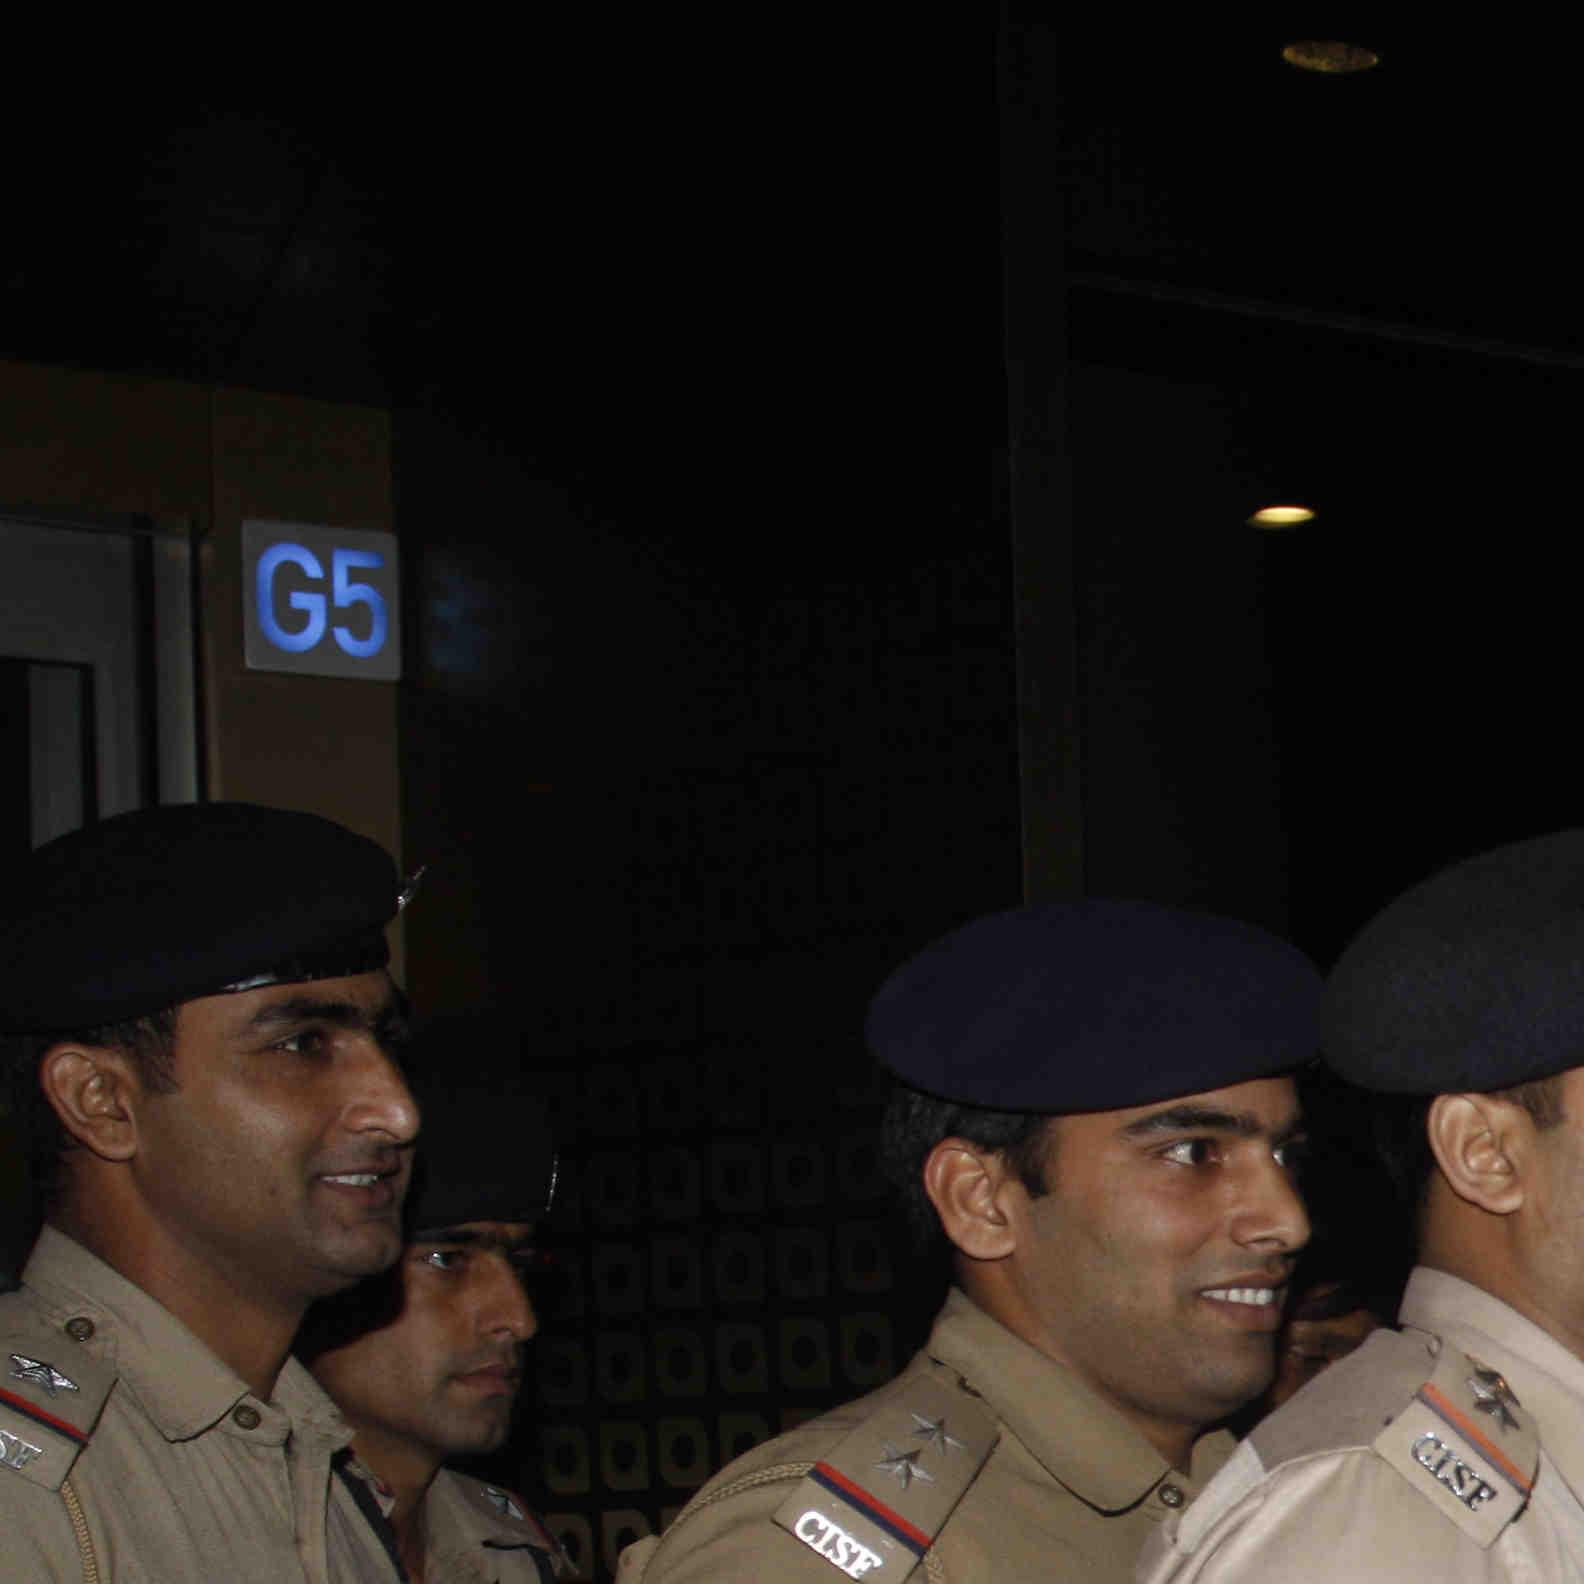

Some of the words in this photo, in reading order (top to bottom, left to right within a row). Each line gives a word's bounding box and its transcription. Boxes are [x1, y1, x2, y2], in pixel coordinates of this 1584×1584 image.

[256, 541, 388, 657] G5
[1411, 1431, 1497, 1512] CISF
[794, 1511, 883, 1580] CISF
